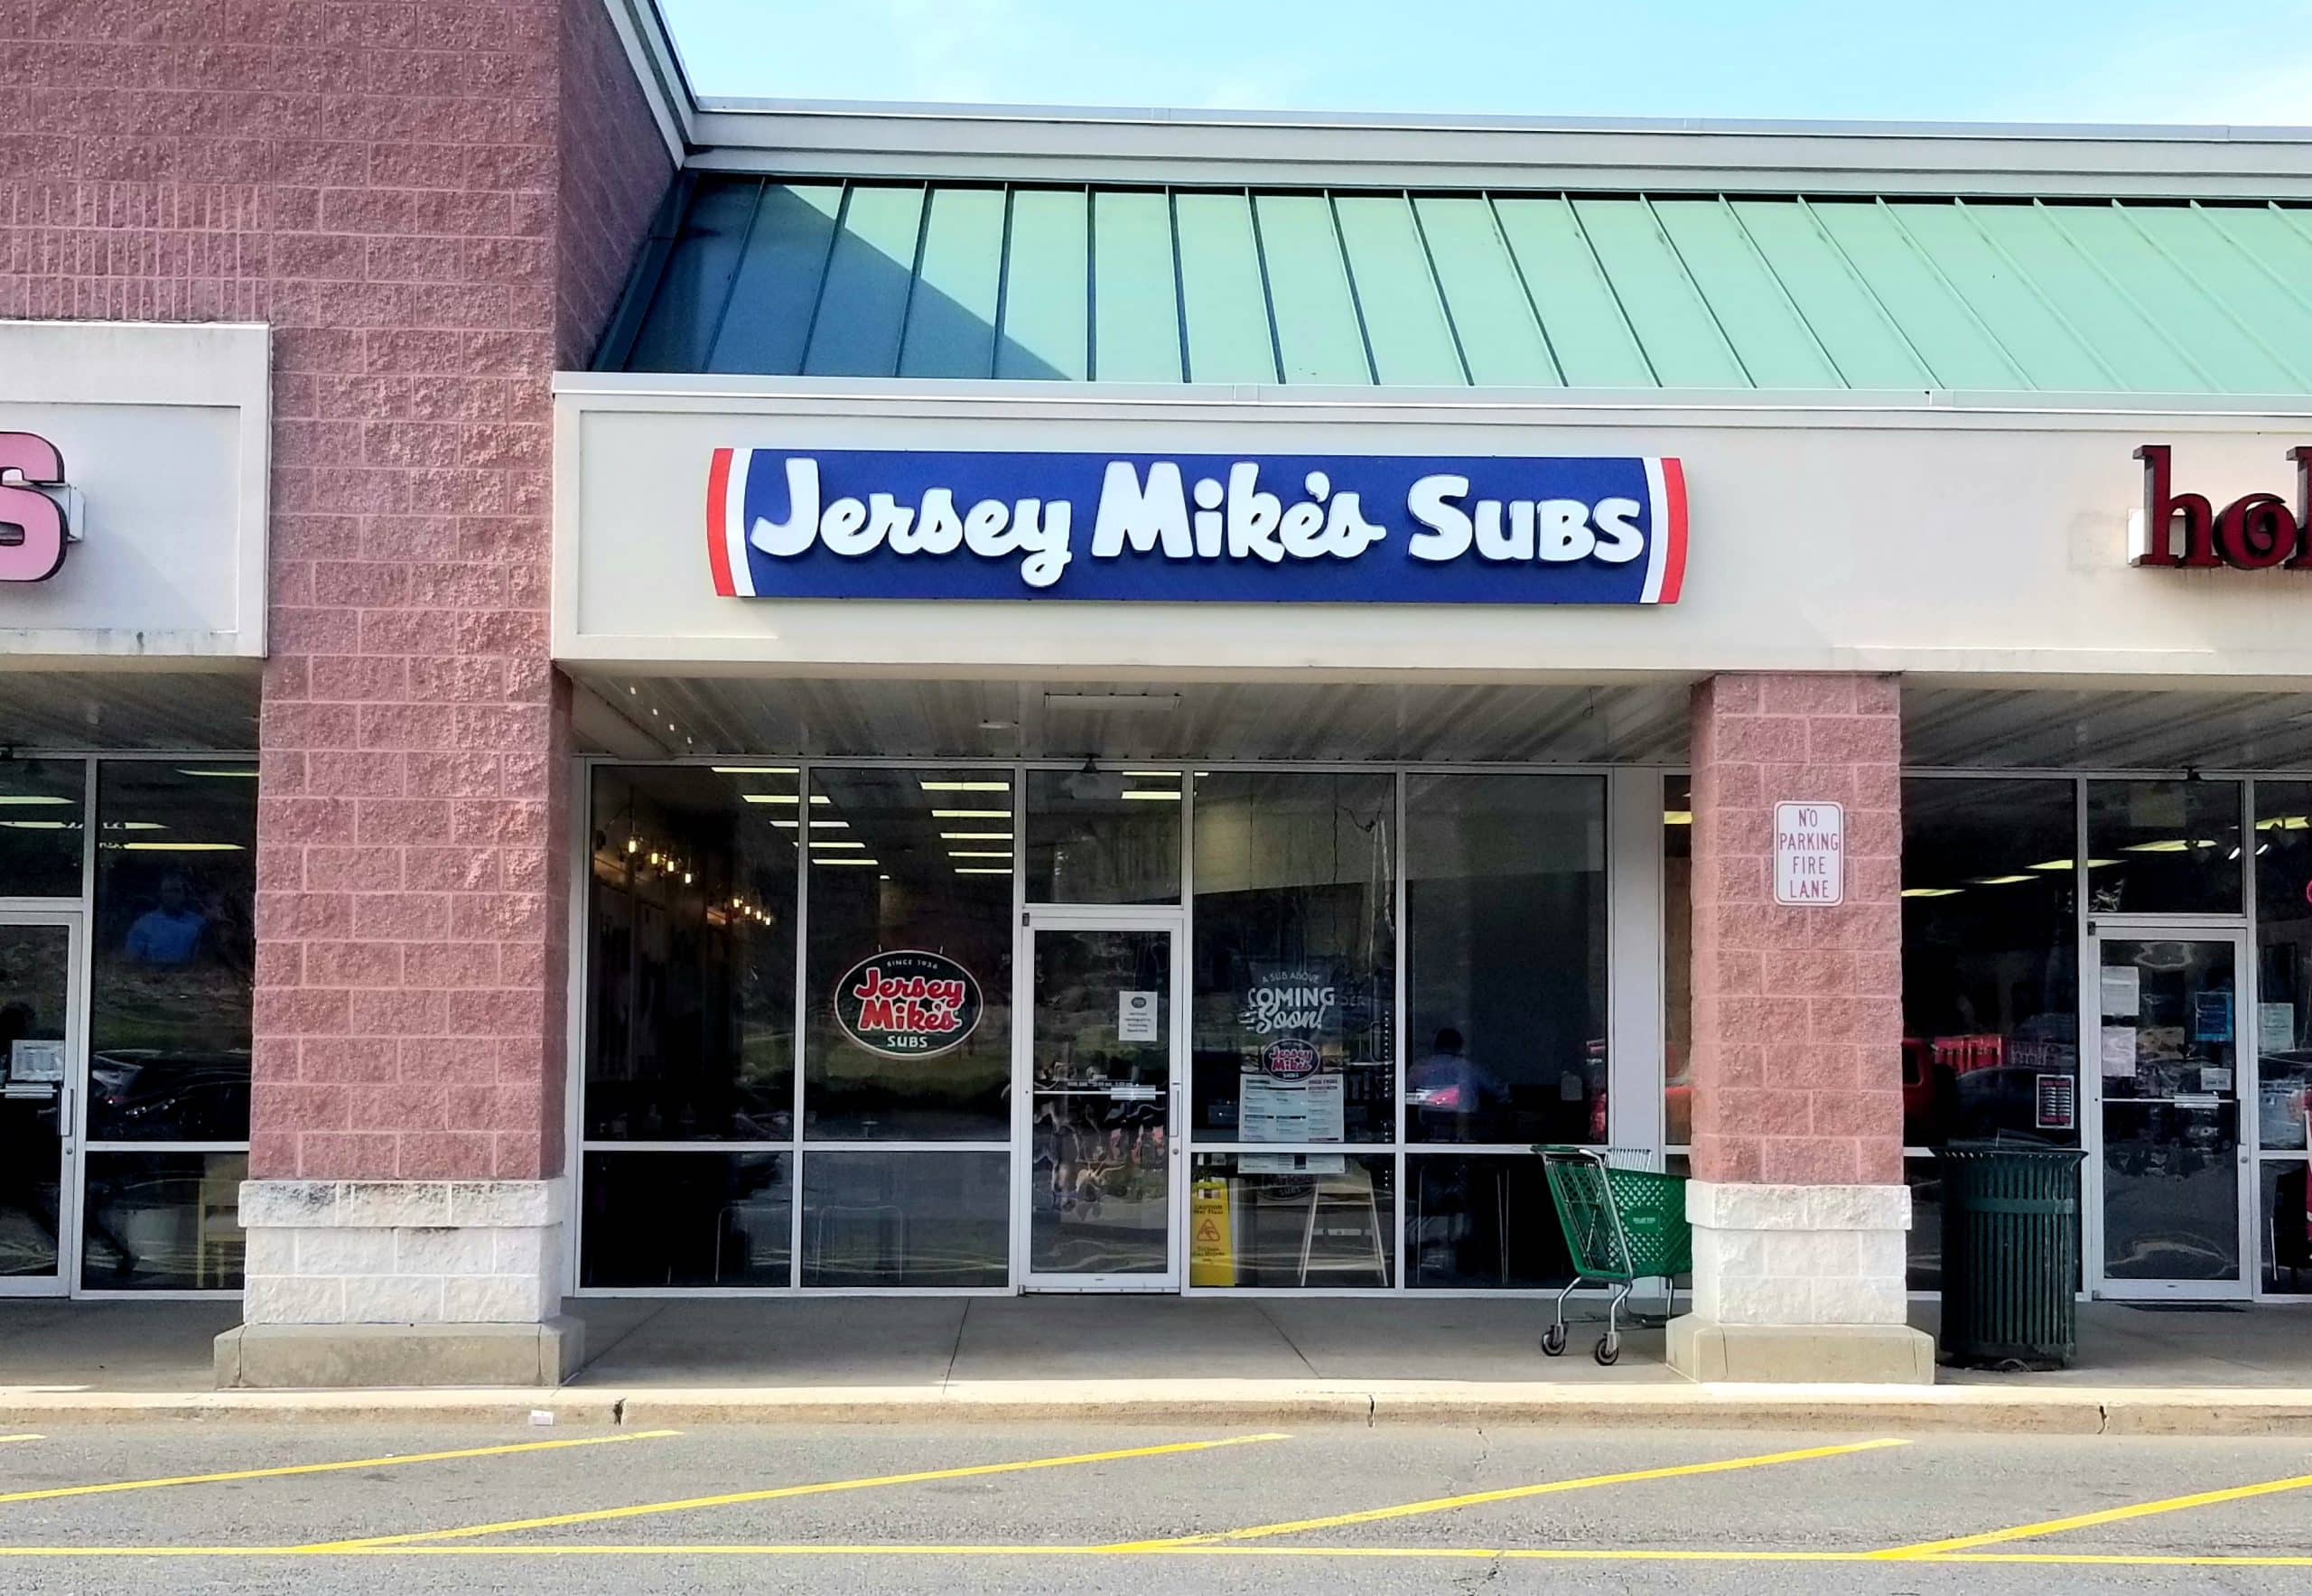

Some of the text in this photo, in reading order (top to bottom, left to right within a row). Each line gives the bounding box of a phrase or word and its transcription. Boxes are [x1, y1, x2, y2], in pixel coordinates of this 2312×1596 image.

[2131, 444, 2312, 571] ho
[750, 457, 1645, 587] Jersey Mike's SUBS
[1798, 808, 1818, 827] NO
[1780, 833, 1839, 851] PARKING
[1793, 855, 1826, 874] FIRE
[1790, 880, 1830, 898] LANE
[887, 958, 912, 968] SINCE
[853, 967, 965, 1009] Jersey
[1247, 986, 1335, 1008] COMING
[859, 999, 962, 1032] Mike's
[887, 1035, 928, 1048] SUBS
